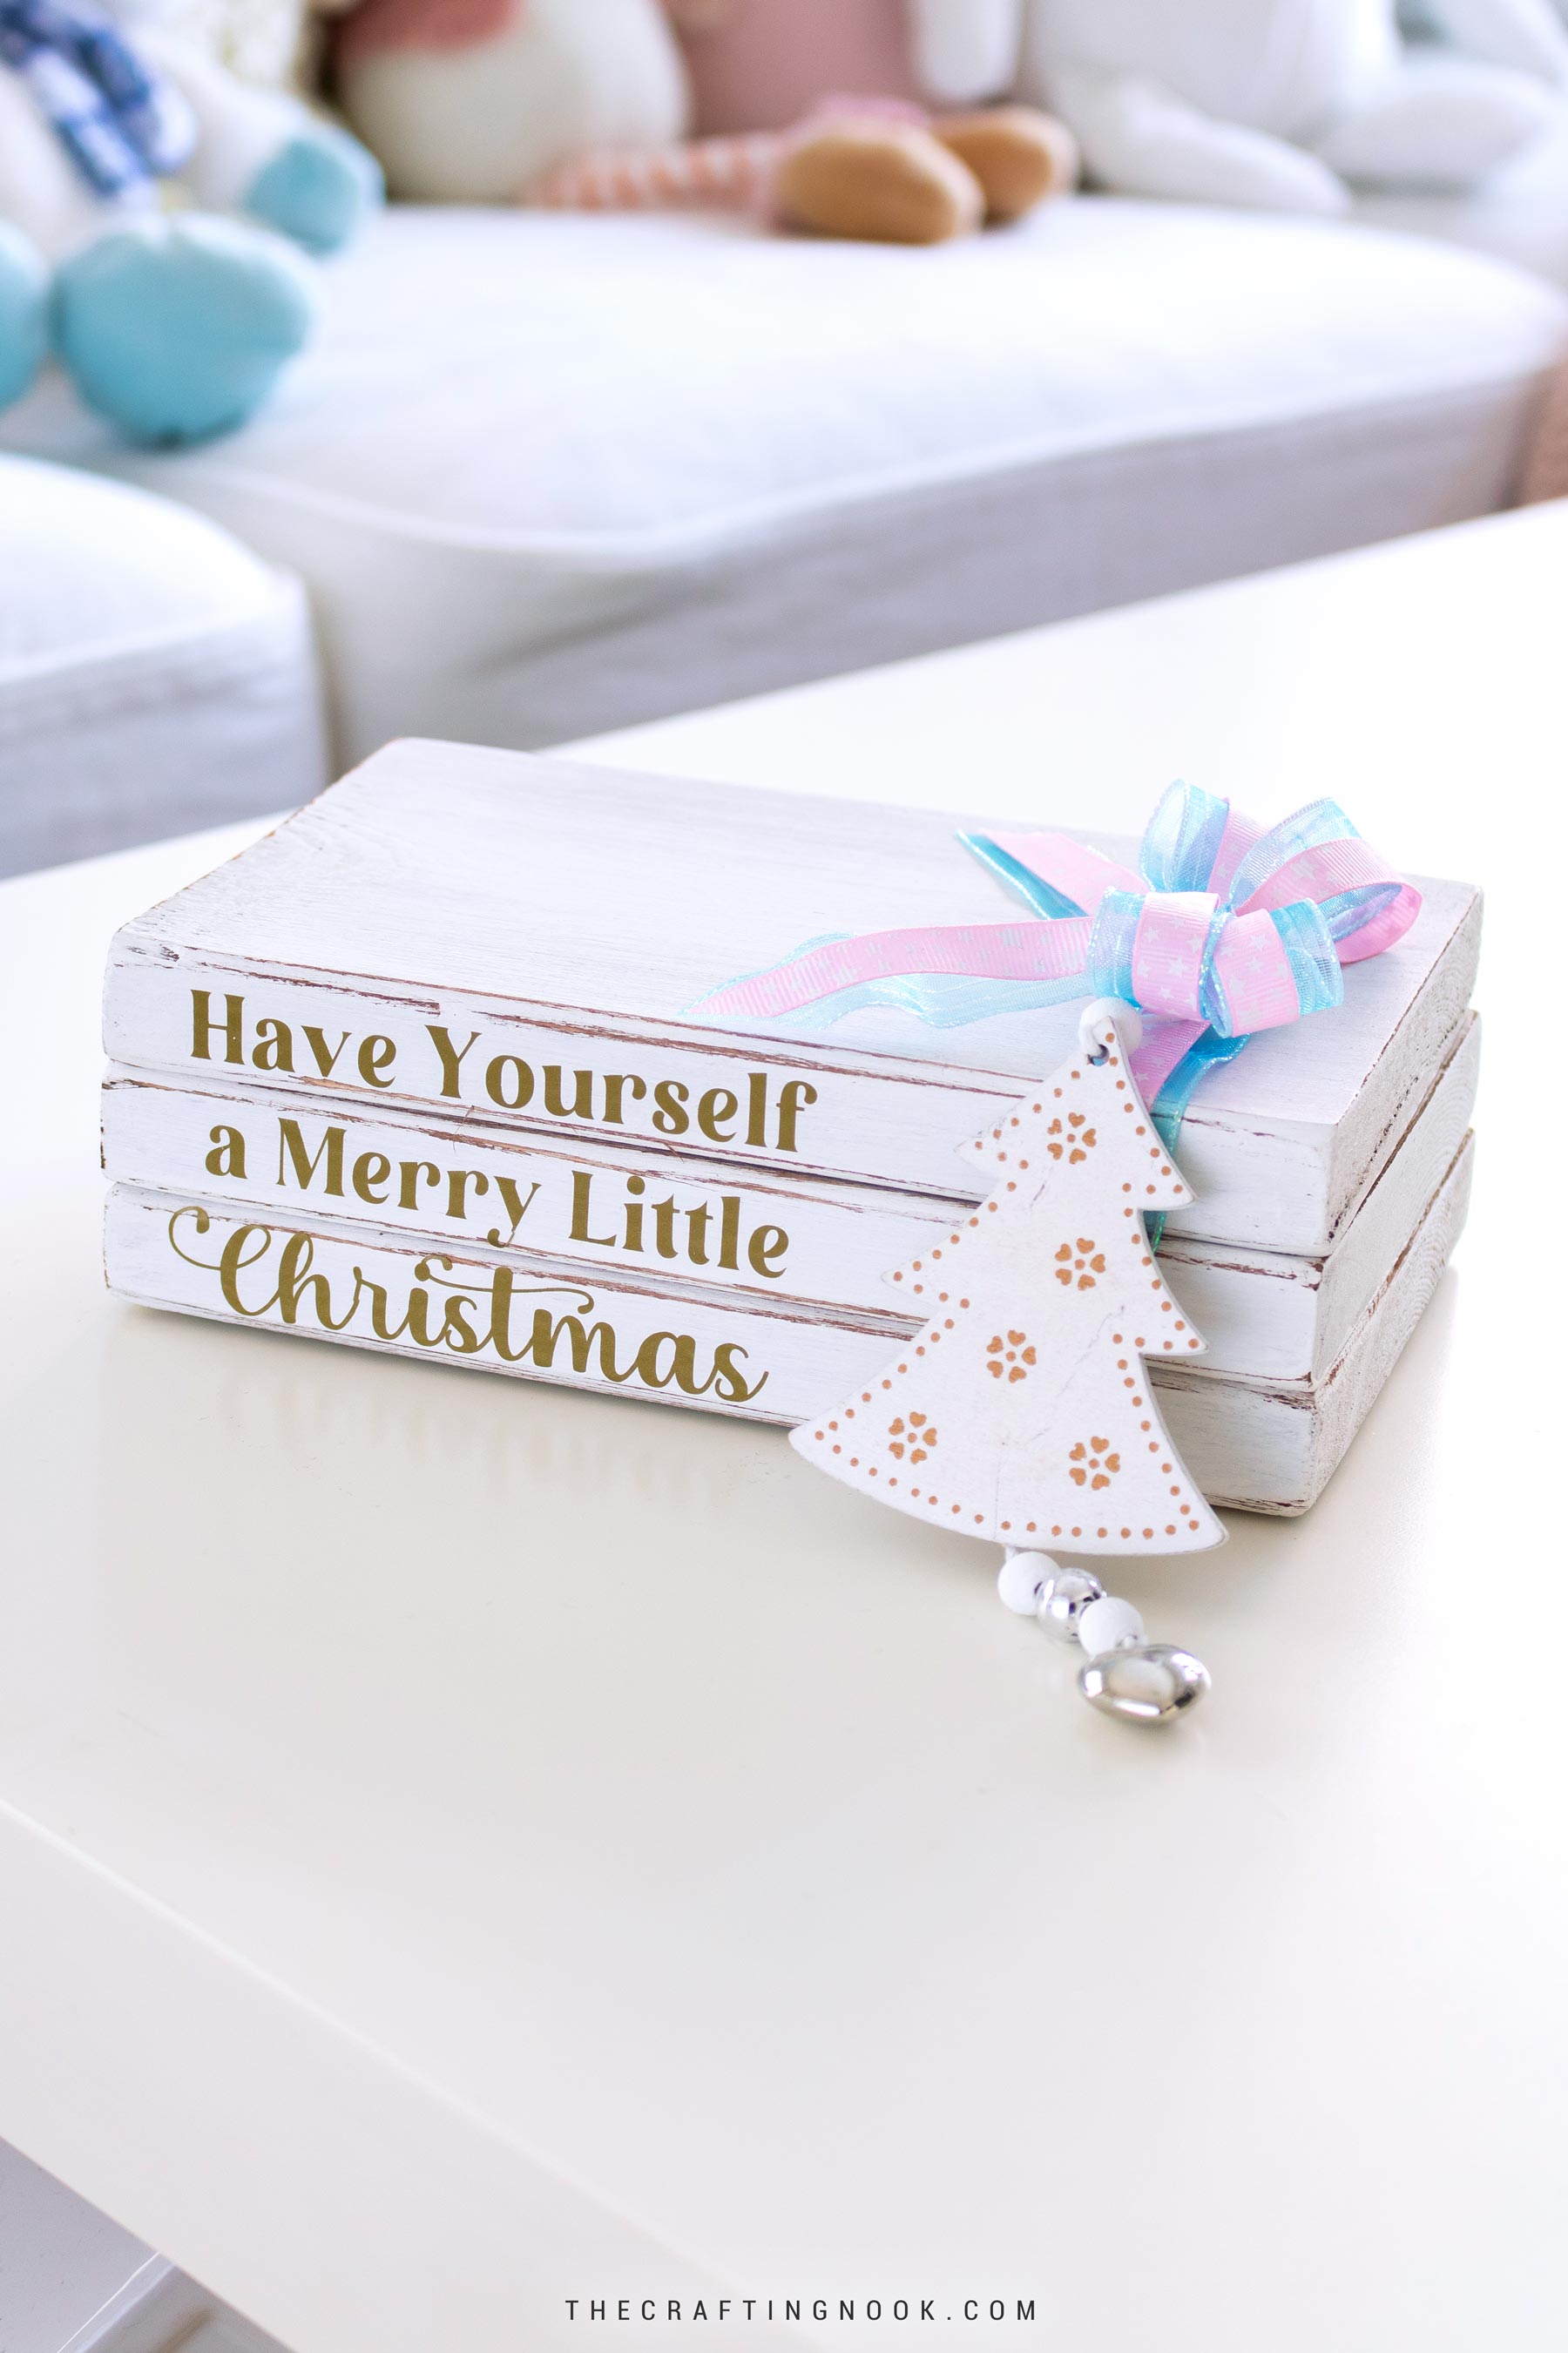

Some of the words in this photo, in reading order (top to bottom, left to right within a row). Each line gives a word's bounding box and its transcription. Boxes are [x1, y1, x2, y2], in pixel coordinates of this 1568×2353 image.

[190, 989, 396, 1088] Have
[425, 1024, 819, 1152] Yourself
[205, 1125, 248, 1180] a
[277, 1118, 542, 1248] Merry
[568, 1170, 790, 1279] Little
[168, 1205, 769, 1403] Christmas
